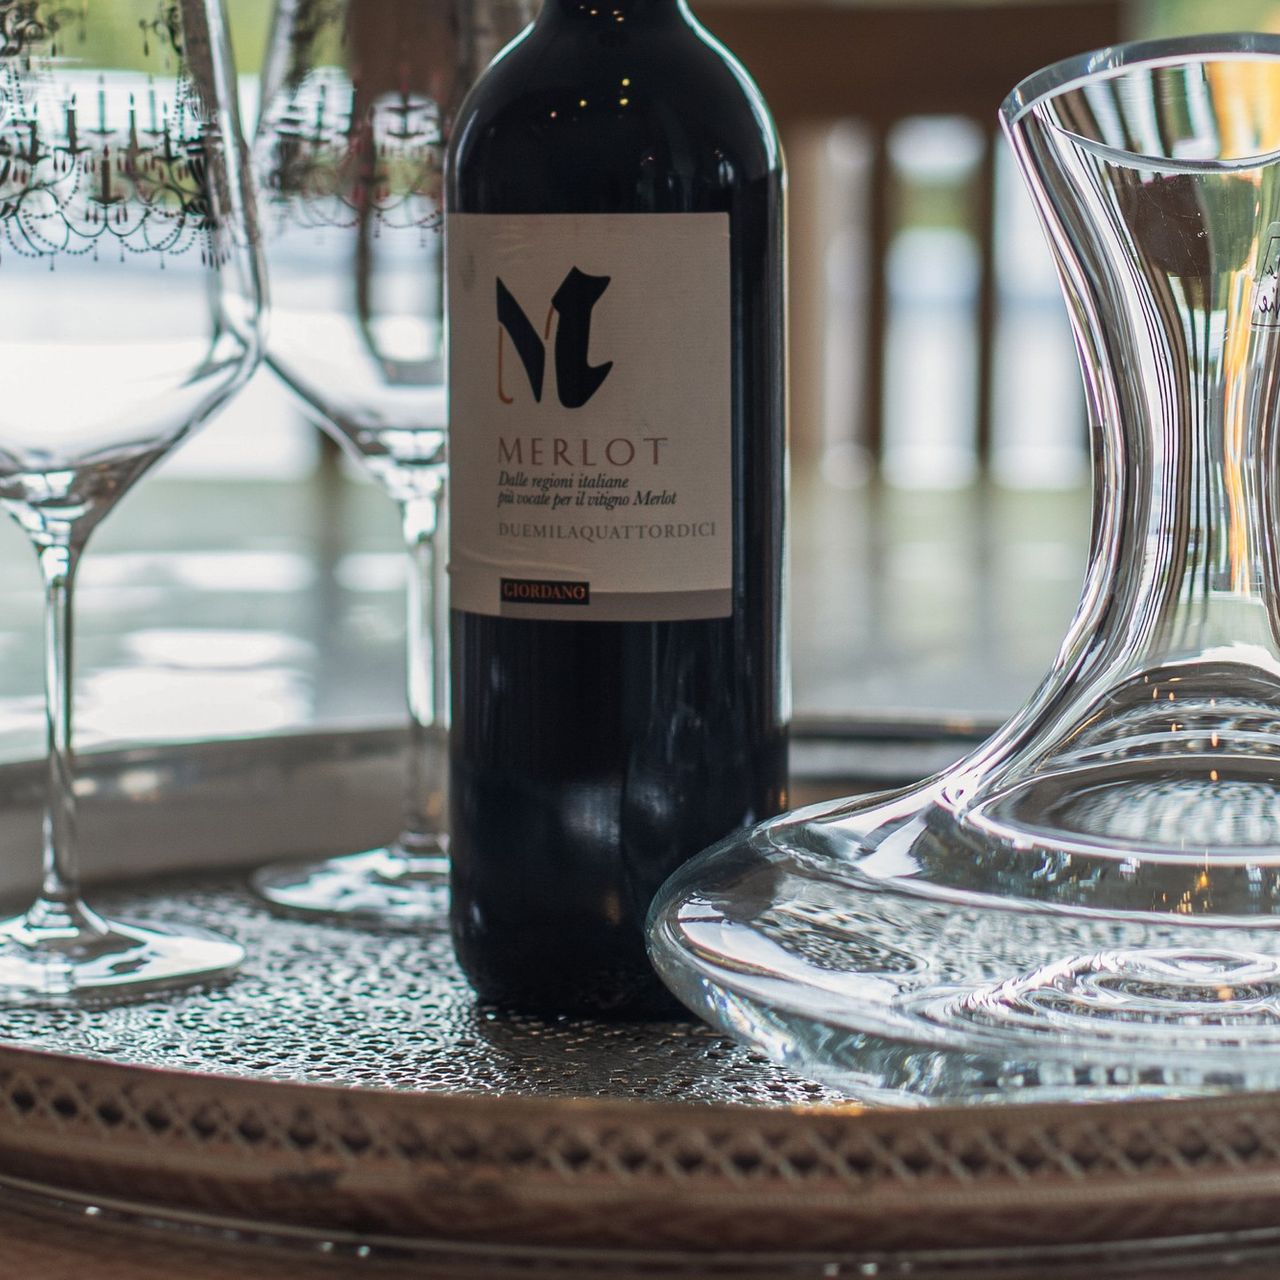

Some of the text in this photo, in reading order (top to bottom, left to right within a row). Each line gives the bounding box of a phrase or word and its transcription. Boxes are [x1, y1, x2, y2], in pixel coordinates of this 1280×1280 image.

[498, 437, 668, 466] MERLOT
[497, 470, 630, 492] Dalle regioni italiane
[497, 489, 678, 511] più vocate per il vitigno Merlot
[498, 522, 718, 543] DUEMILAQUATTORDICI
[503, 581, 586, 601] GIORDANO
